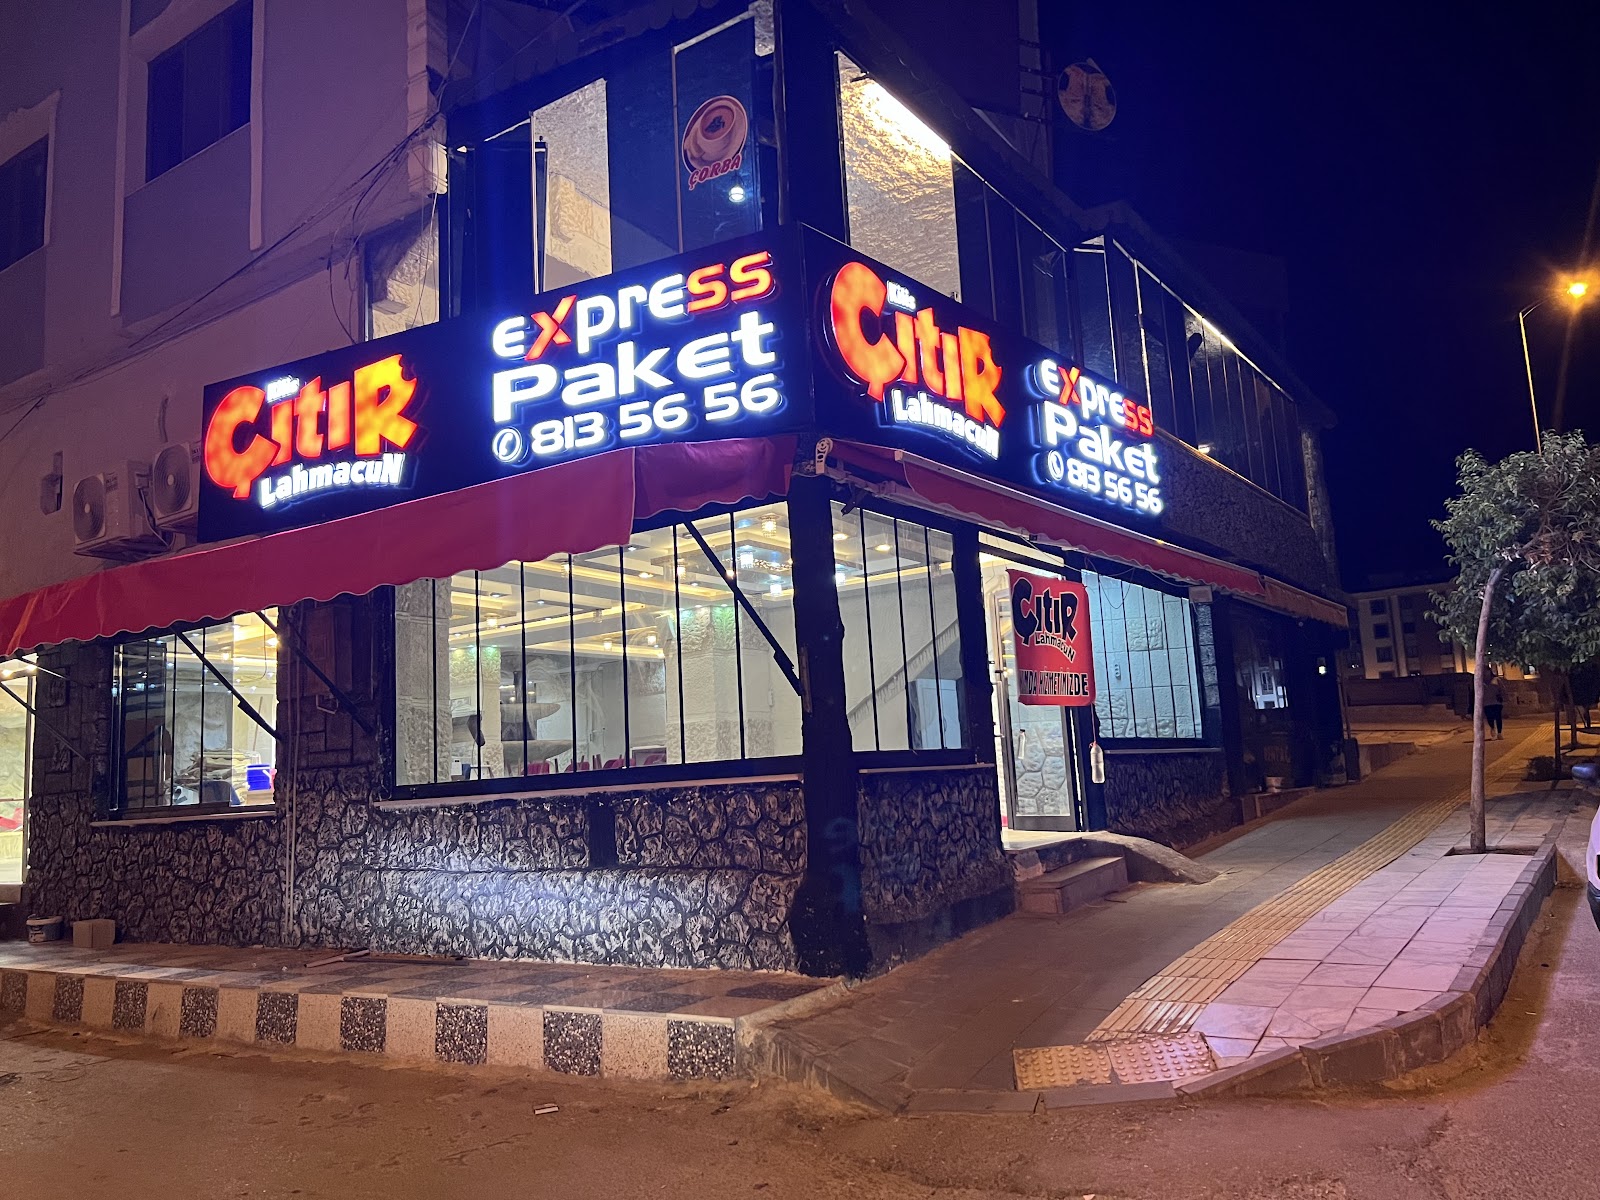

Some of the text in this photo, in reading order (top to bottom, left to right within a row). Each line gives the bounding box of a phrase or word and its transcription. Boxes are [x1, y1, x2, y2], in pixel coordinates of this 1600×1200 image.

[688, 153, 742, 191] ÇORBA
[492, 310, 776, 423] Paket
[531, 372, 779, 455] 813 56 56
[1044, 401, 1161, 485] Paket
[1066, 457, 1164, 514] 813 56 56
